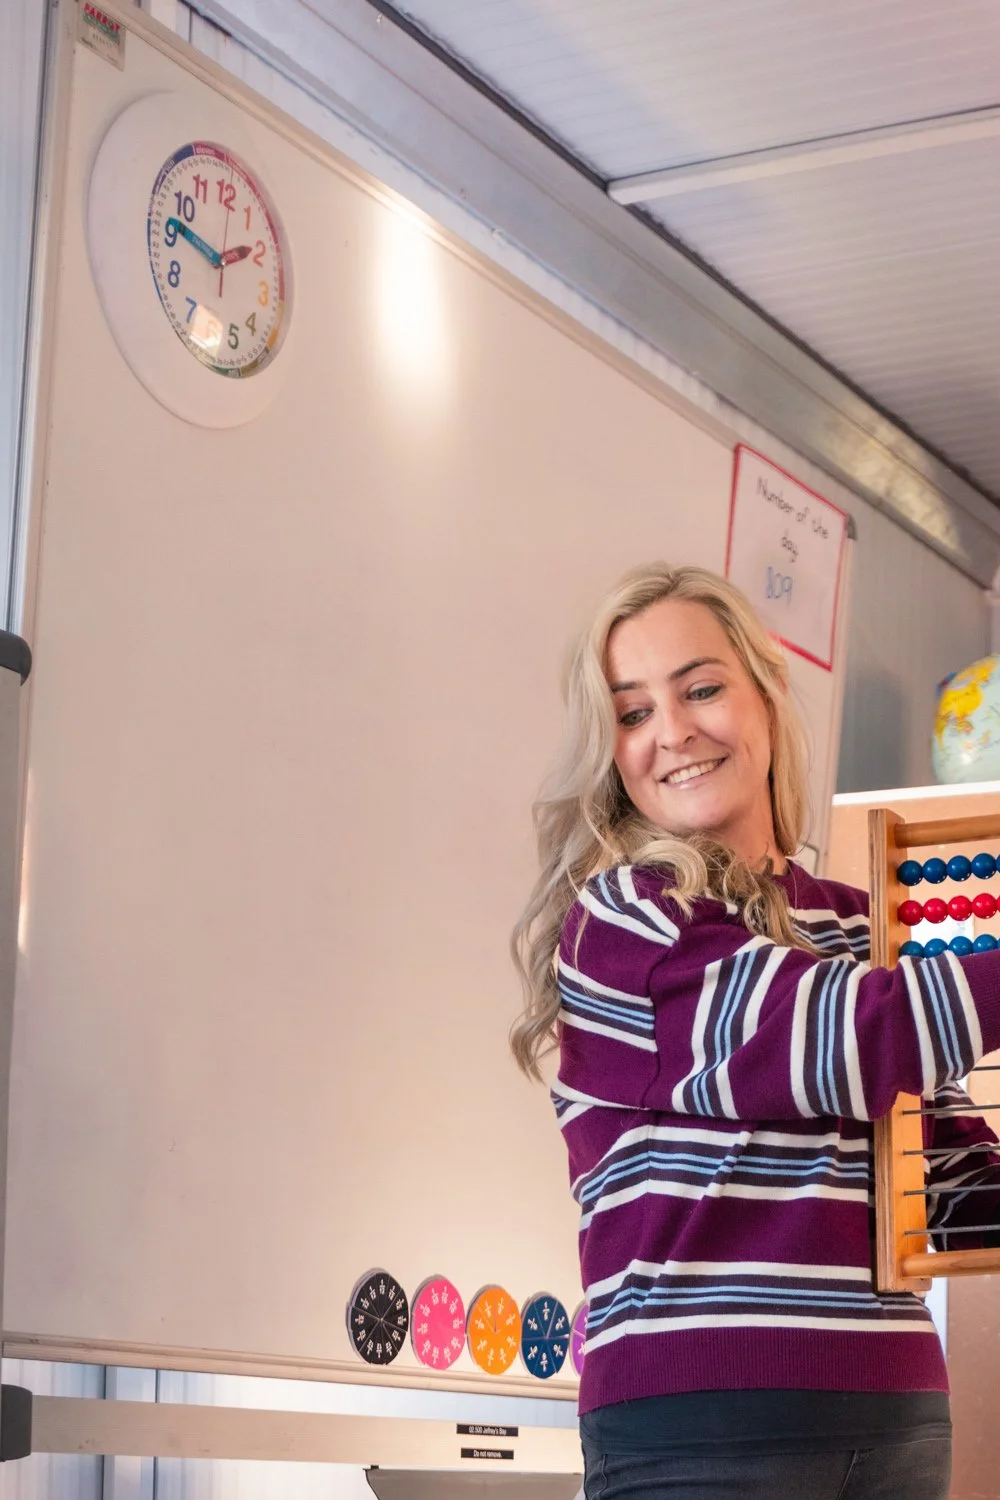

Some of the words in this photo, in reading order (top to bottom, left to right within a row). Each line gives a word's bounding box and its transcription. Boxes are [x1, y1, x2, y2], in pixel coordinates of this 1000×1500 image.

[192, 173, 208, 205] 11
[216, 178, 237, 213] 12
[174, 189, 196, 223] 10
[243, 204, 251, 231] 1
[164, 217, 178, 248] 9
[253, 239, 266, 268] 2
[167, 259, 181, 288] 8
[258, 281, 270, 308] 3
[185, 296, 198, 324] 7
[245, 311, 257, 336] 4
[227, 323, 240, 350] 5
[756, 476, 795, 514] Number
[795, 506, 810, 522] of
[811, 515, 829, 540] the
